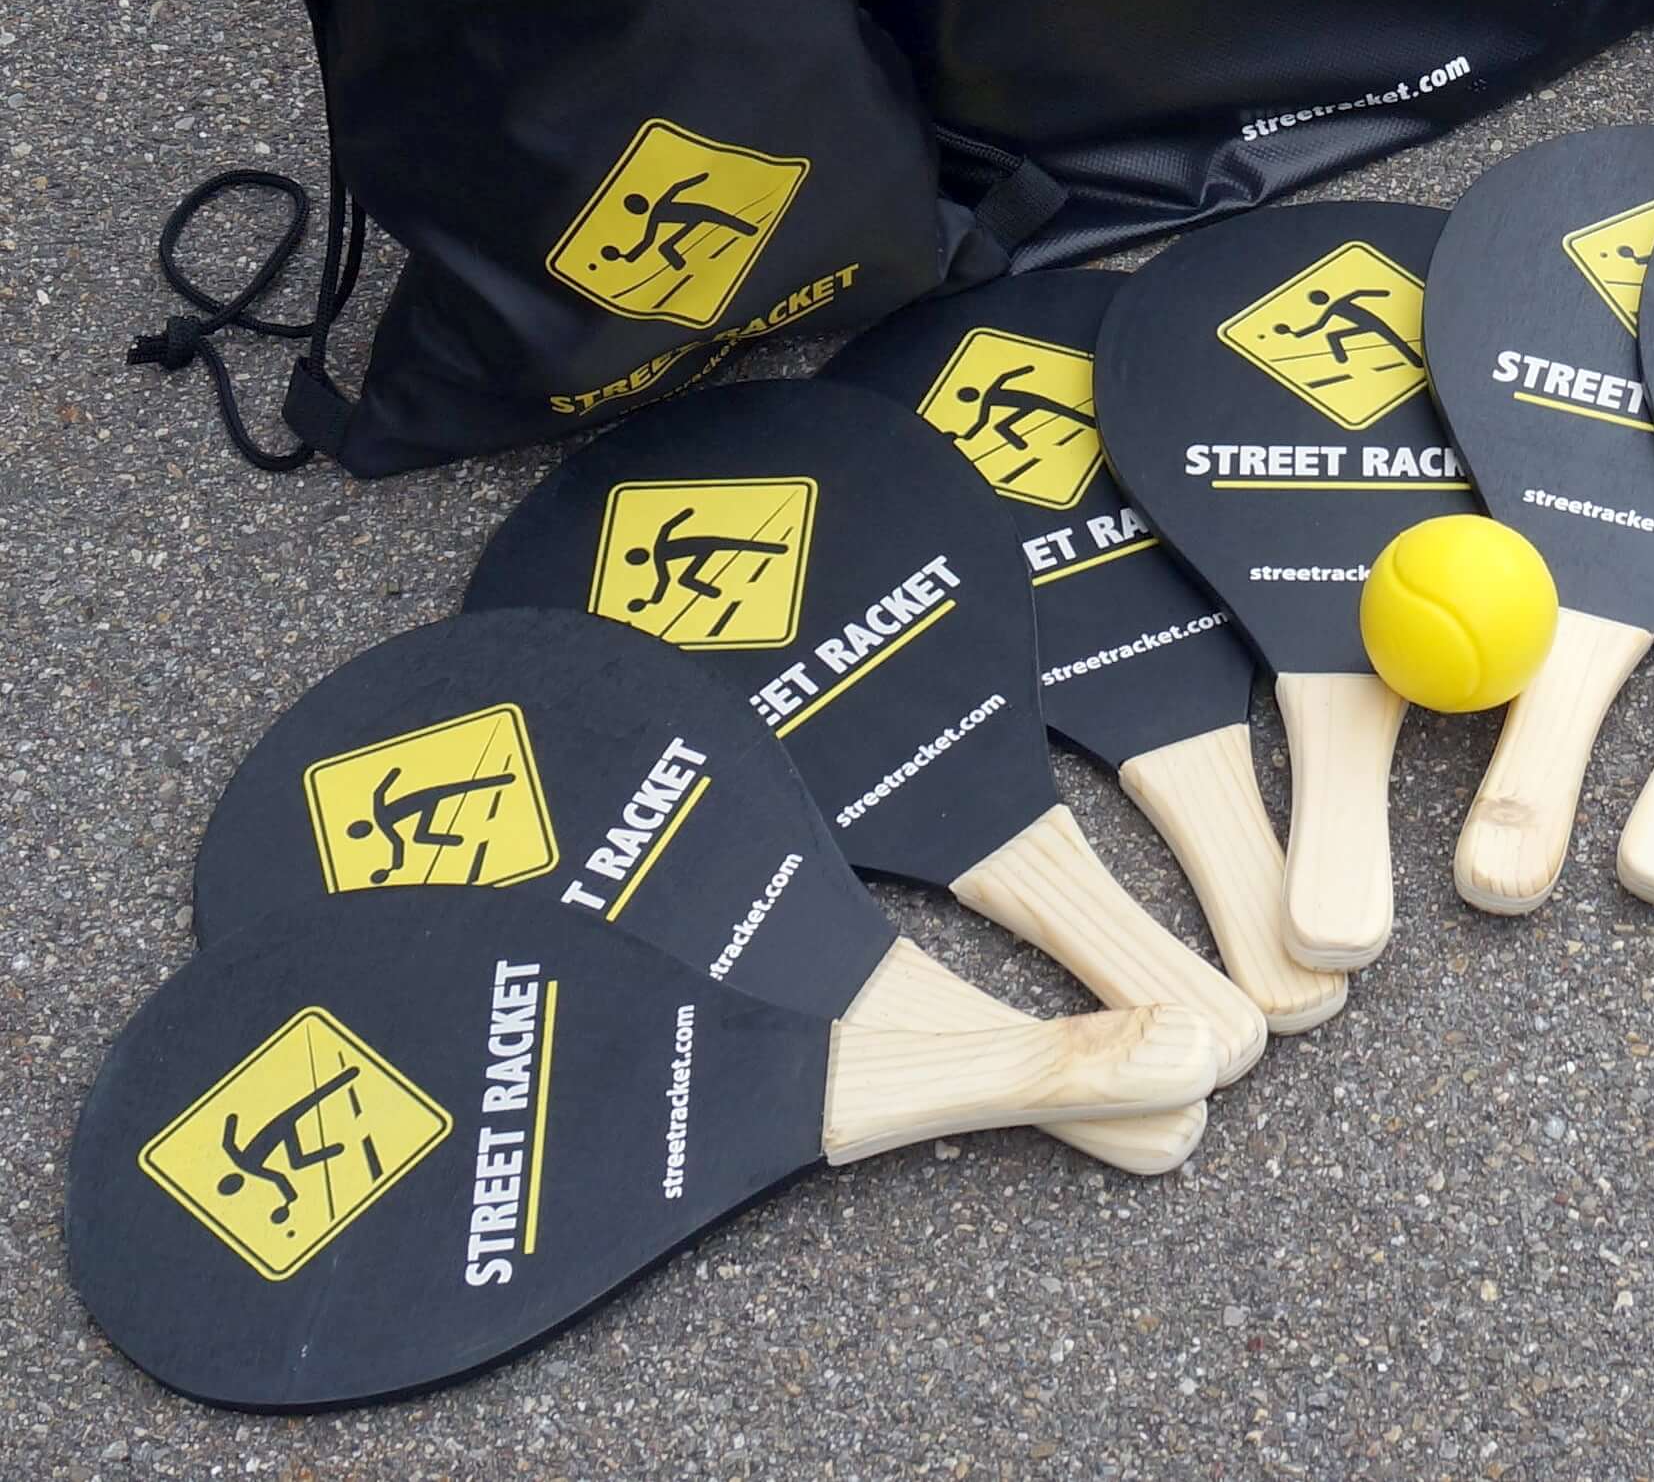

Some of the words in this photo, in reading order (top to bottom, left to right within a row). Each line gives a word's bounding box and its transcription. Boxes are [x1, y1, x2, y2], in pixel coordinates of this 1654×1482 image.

[1241, 55, 1471, 142] streetracket.com
[1491, 349, 1644, 415] STREET
[1185, 444, 1348, 476] STREET
[814, 554, 961, 675] RACKET
[584, 736, 708, 881] RACKET
[835, 694, 1007, 828] streetracket.com
[481, 959, 541, 1113] RACKET
[662, 1004, 695, 1199] streetracket.com
[464, 1126, 525, 1287] STREET
